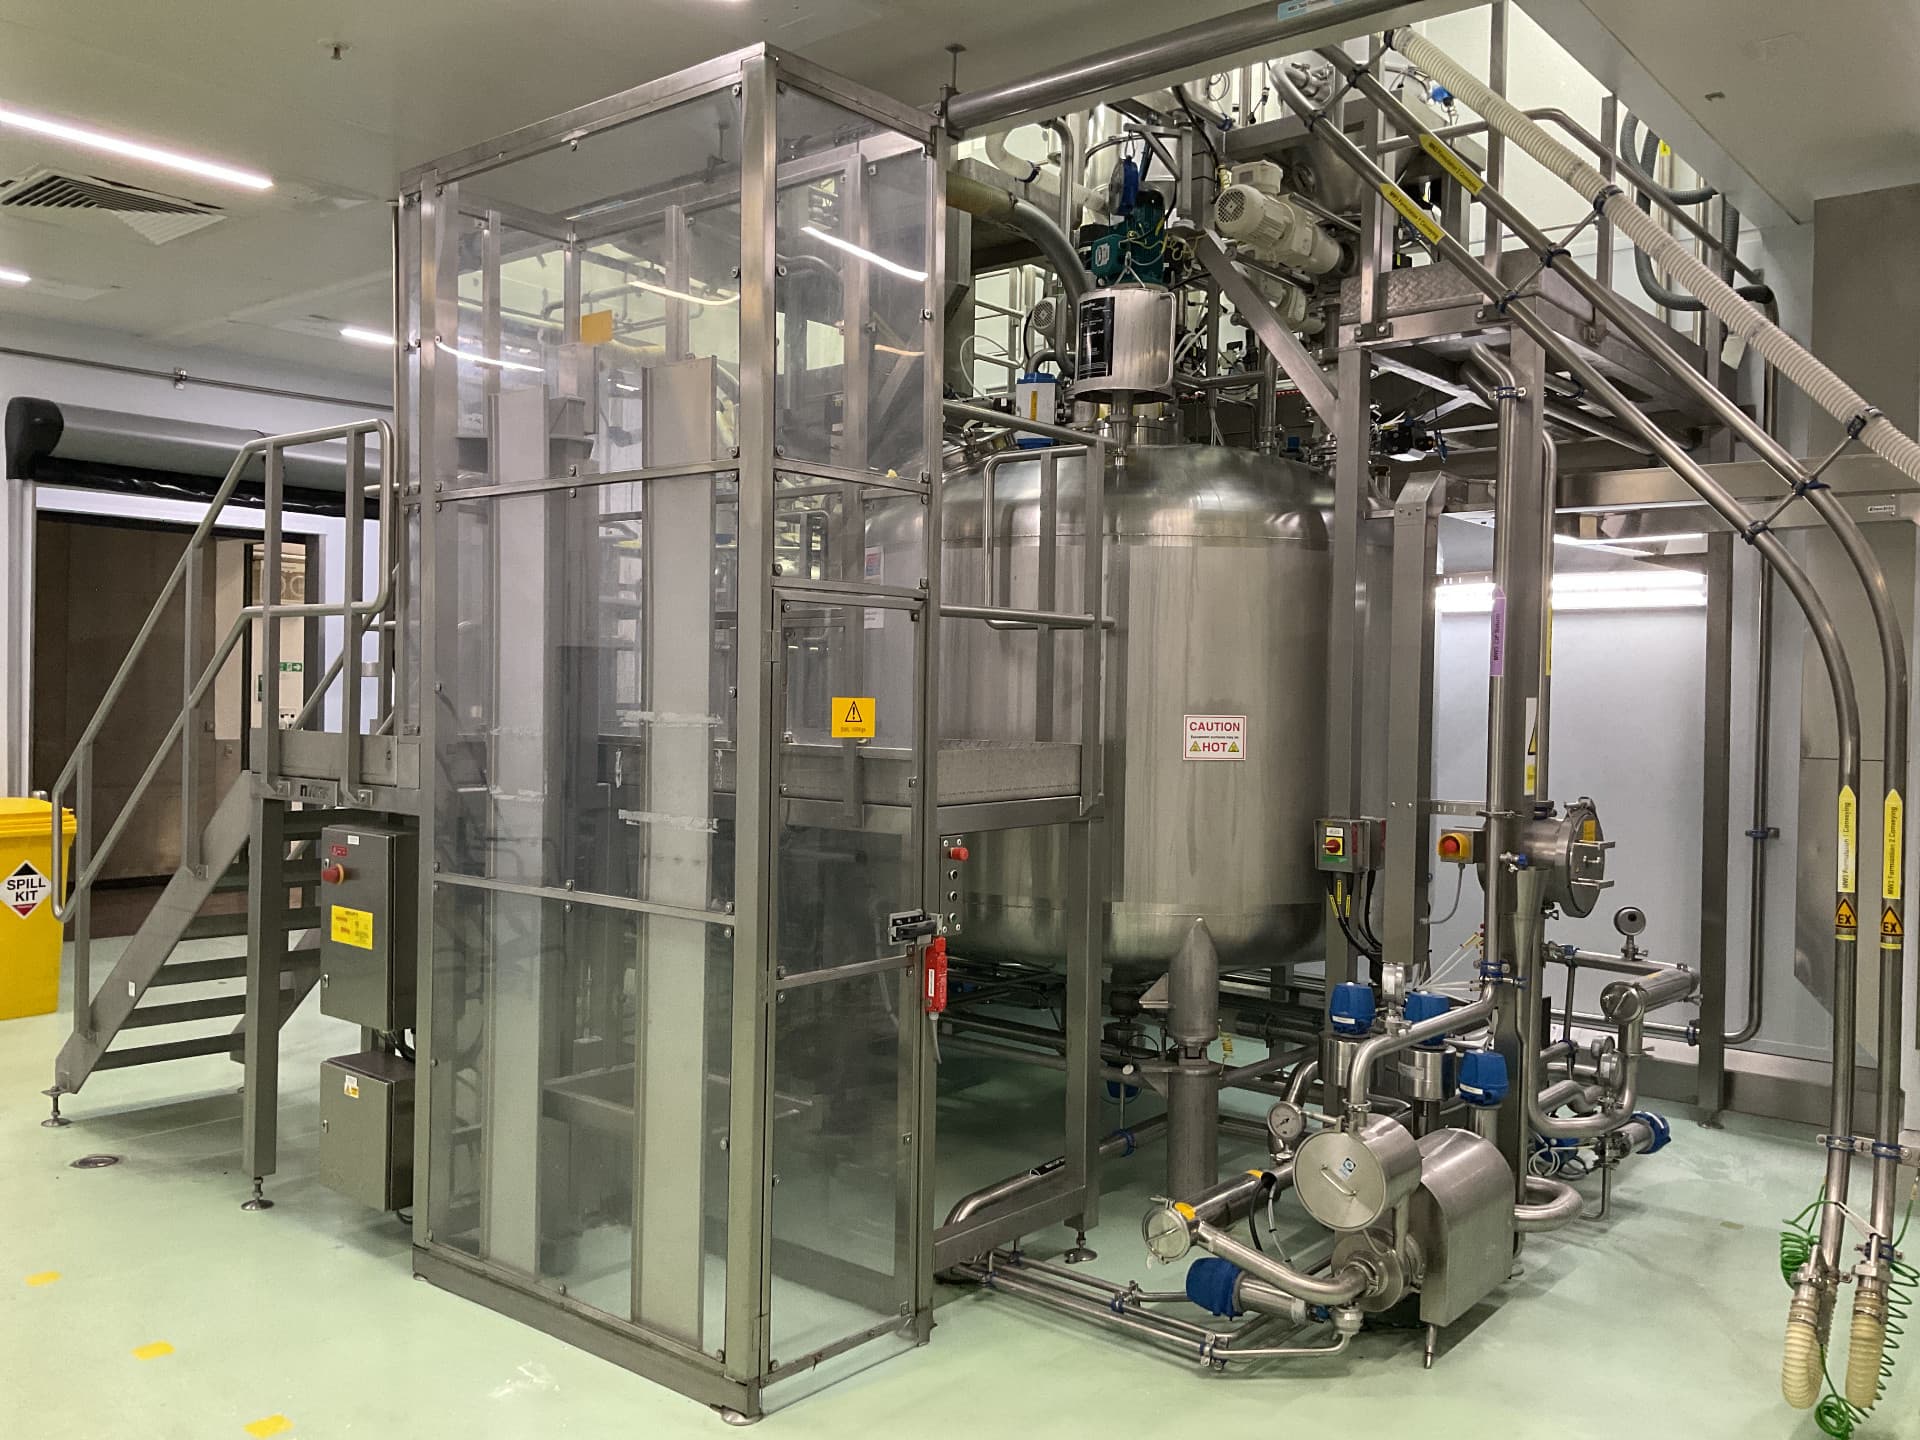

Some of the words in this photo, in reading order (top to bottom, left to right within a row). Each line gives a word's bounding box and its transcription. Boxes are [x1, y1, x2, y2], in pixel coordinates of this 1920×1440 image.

[1190, 721, 1240, 731] CAUTION
[1202, 742, 1228, 752] HOT
[1843, 801, 1852, 833] Conveying
[1889, 806, 1898, 838] Conveying
[7, 877, 46, 890] SPILL
[15, 890, 38, 901] KIT
[1838, 914, 1852, 925] EX
[1883, 921, 1897, 933] EX
